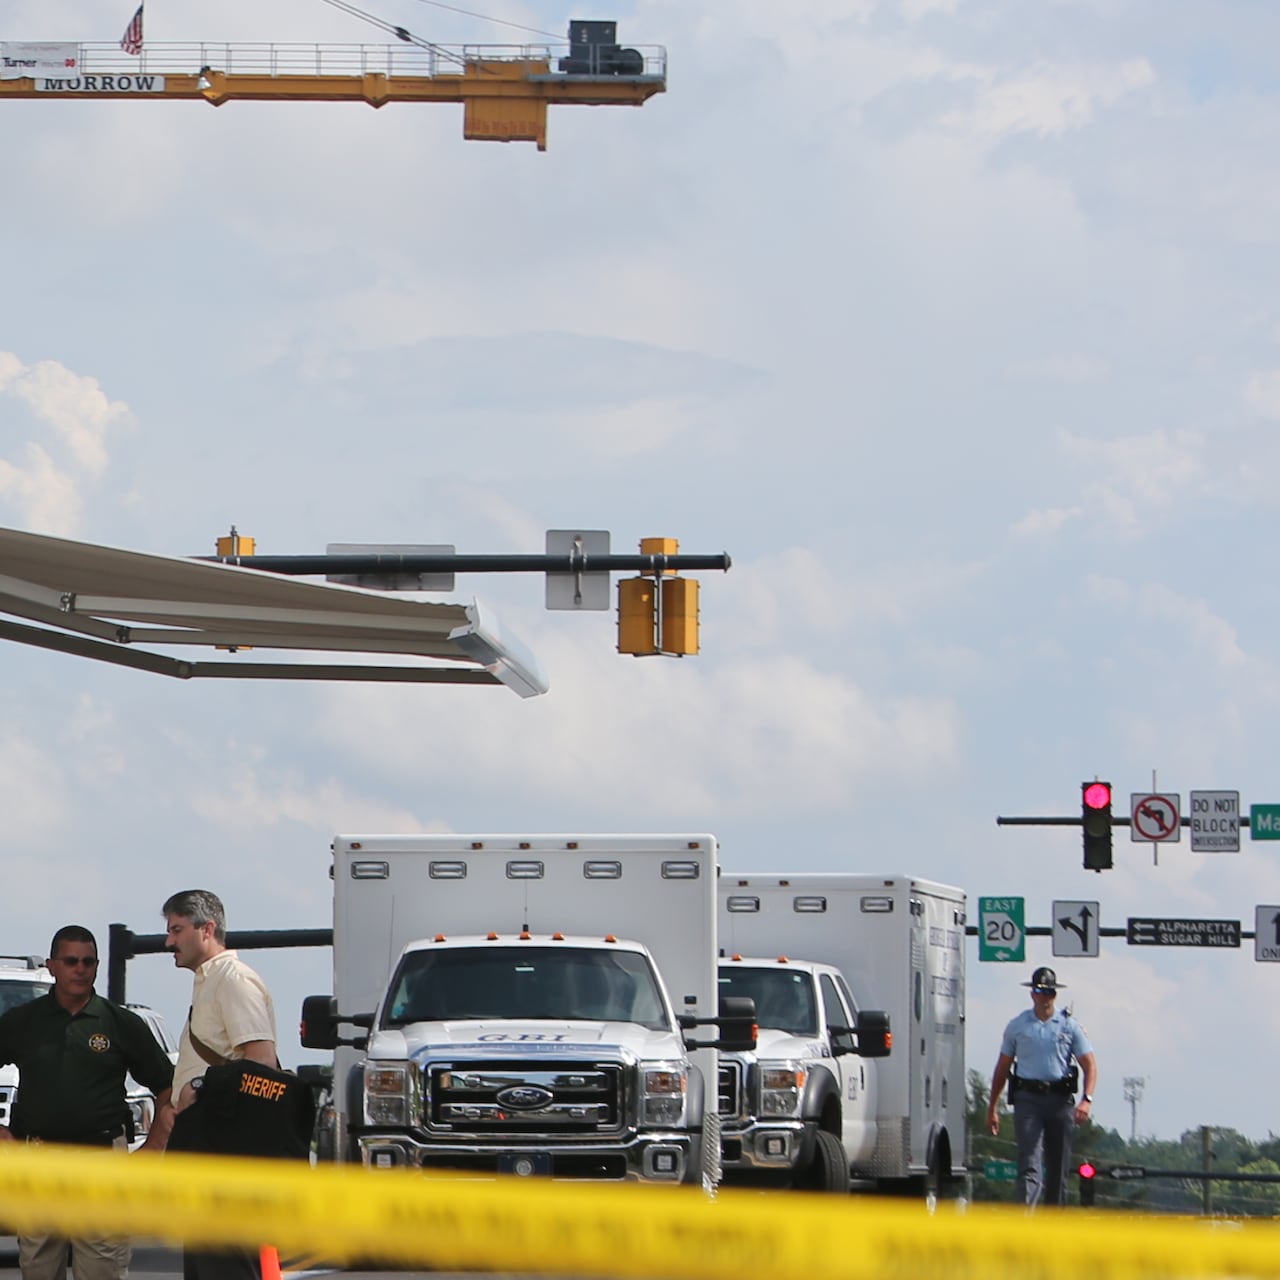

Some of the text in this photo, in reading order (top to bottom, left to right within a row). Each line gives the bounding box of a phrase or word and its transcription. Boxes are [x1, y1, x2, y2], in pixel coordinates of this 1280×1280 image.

[2, 57, 37, 68] Turner
[44, 76, 155, 91] MORROW
[1192, 799, 1236, 813] DO NOT
[1193, 818, 1237, 832] BLOCK
[985, 901, 1017, 911] EAST
[986, 921, 1016, 941] 20
[1158, 922, 1236, 934] ALPHARETTA
[1161, 933, 1236, 945] SUGAR HILL
[1261, 948, 1280, 958] ON
[239, 1073, 287, 1102] SHERIFF
